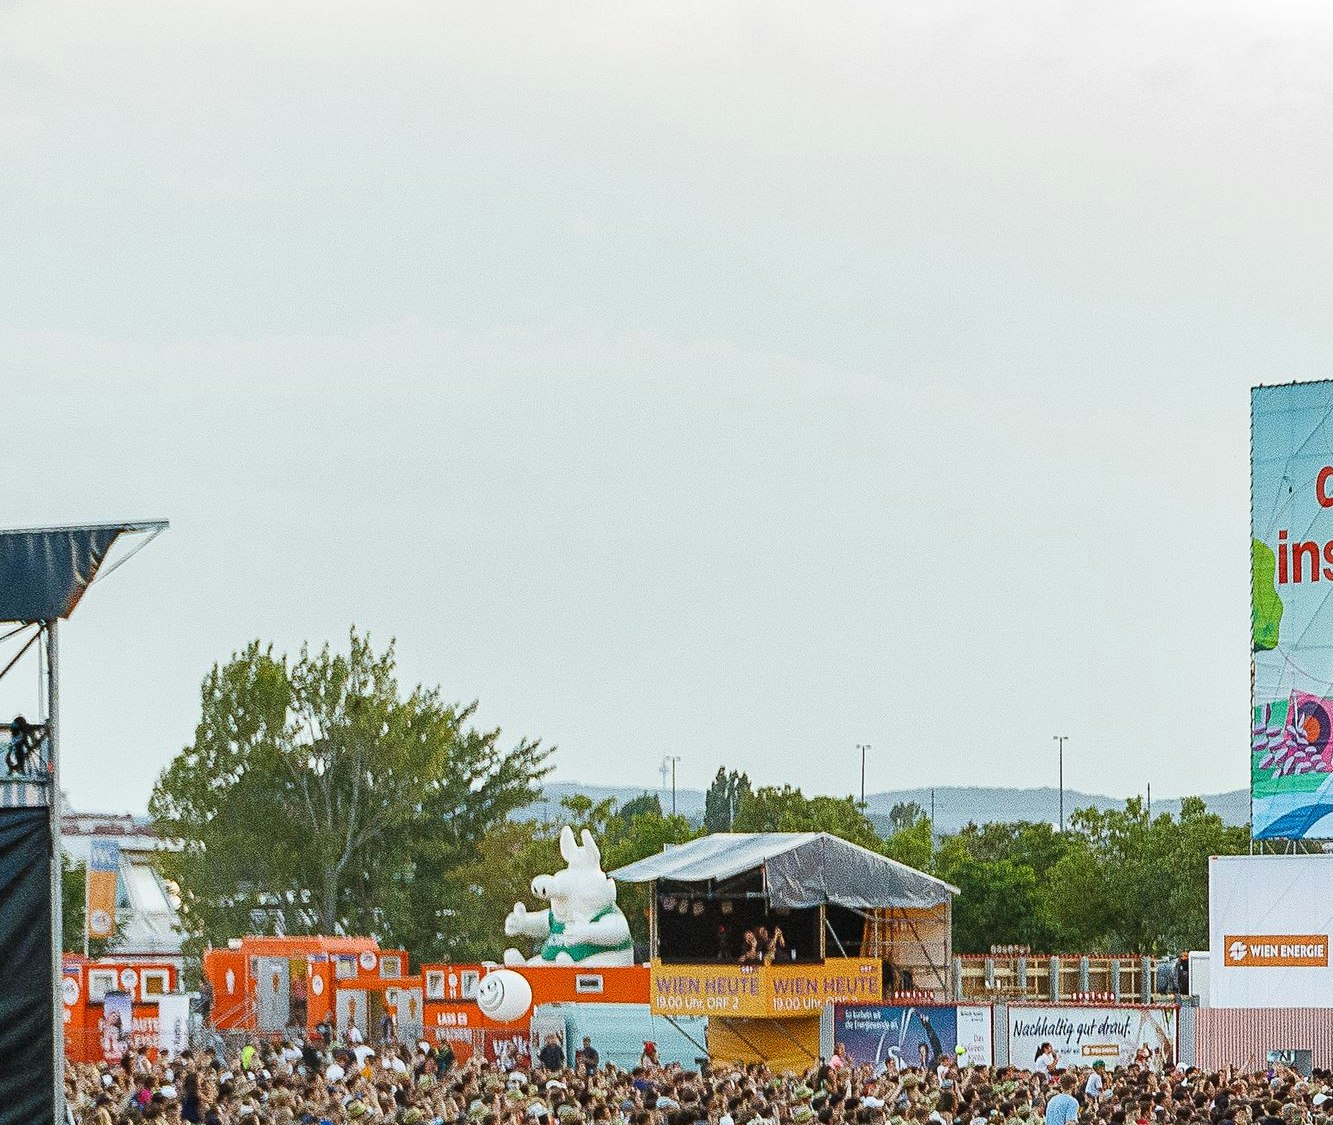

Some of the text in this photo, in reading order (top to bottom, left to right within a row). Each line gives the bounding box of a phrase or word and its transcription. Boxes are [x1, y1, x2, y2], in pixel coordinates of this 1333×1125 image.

[1251, 944, 1324, 959] WIEN ENERGIE
[656, 977, 759, 995] WIEN HEUTE
[773, 977, 818, 995] WIEN
[823, 977, 879, 995] HEUTE
[656, 996, 682, 1010] 19.00
[707, 997, 729, 1009] ORF
[731, 997, 740, 1010] 2
[773, 997, 799, 1011] 19.00
[1014, 1016, 1131, 1044] Nachhaltig gut drauf.
